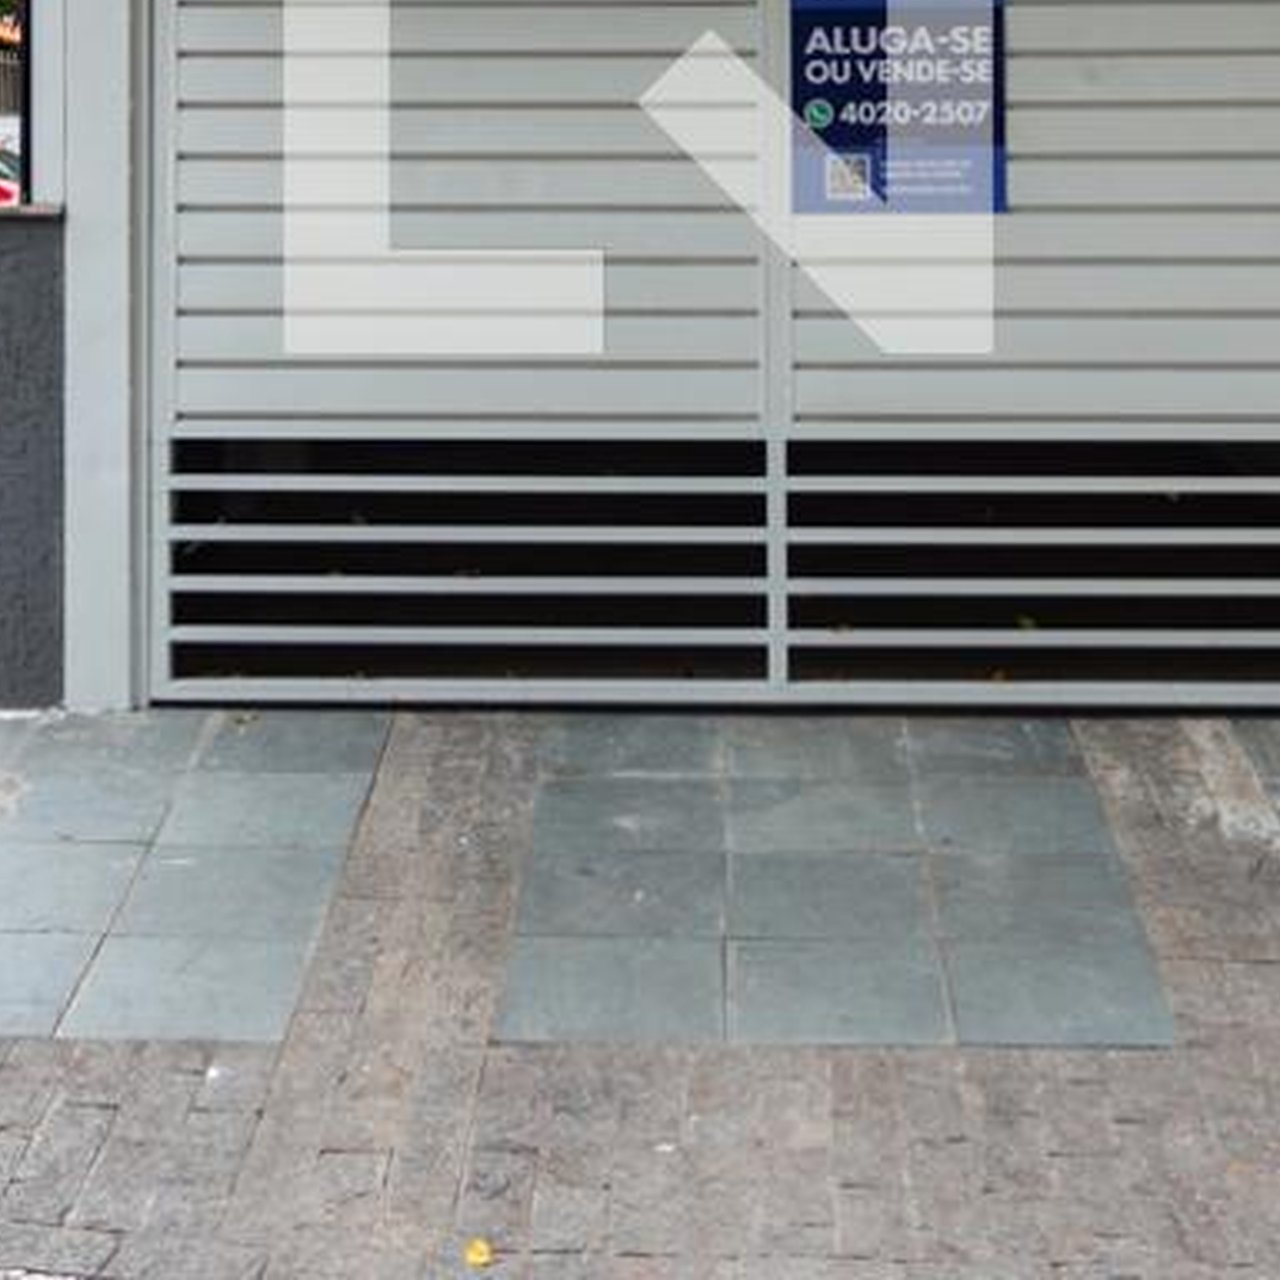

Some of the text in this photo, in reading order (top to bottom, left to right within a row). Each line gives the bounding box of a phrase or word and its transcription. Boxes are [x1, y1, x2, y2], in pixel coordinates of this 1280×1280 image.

[805, 26, 993, 55] ALUGA-SE
[805, 59, 993, 84] OU VENDE-SE
